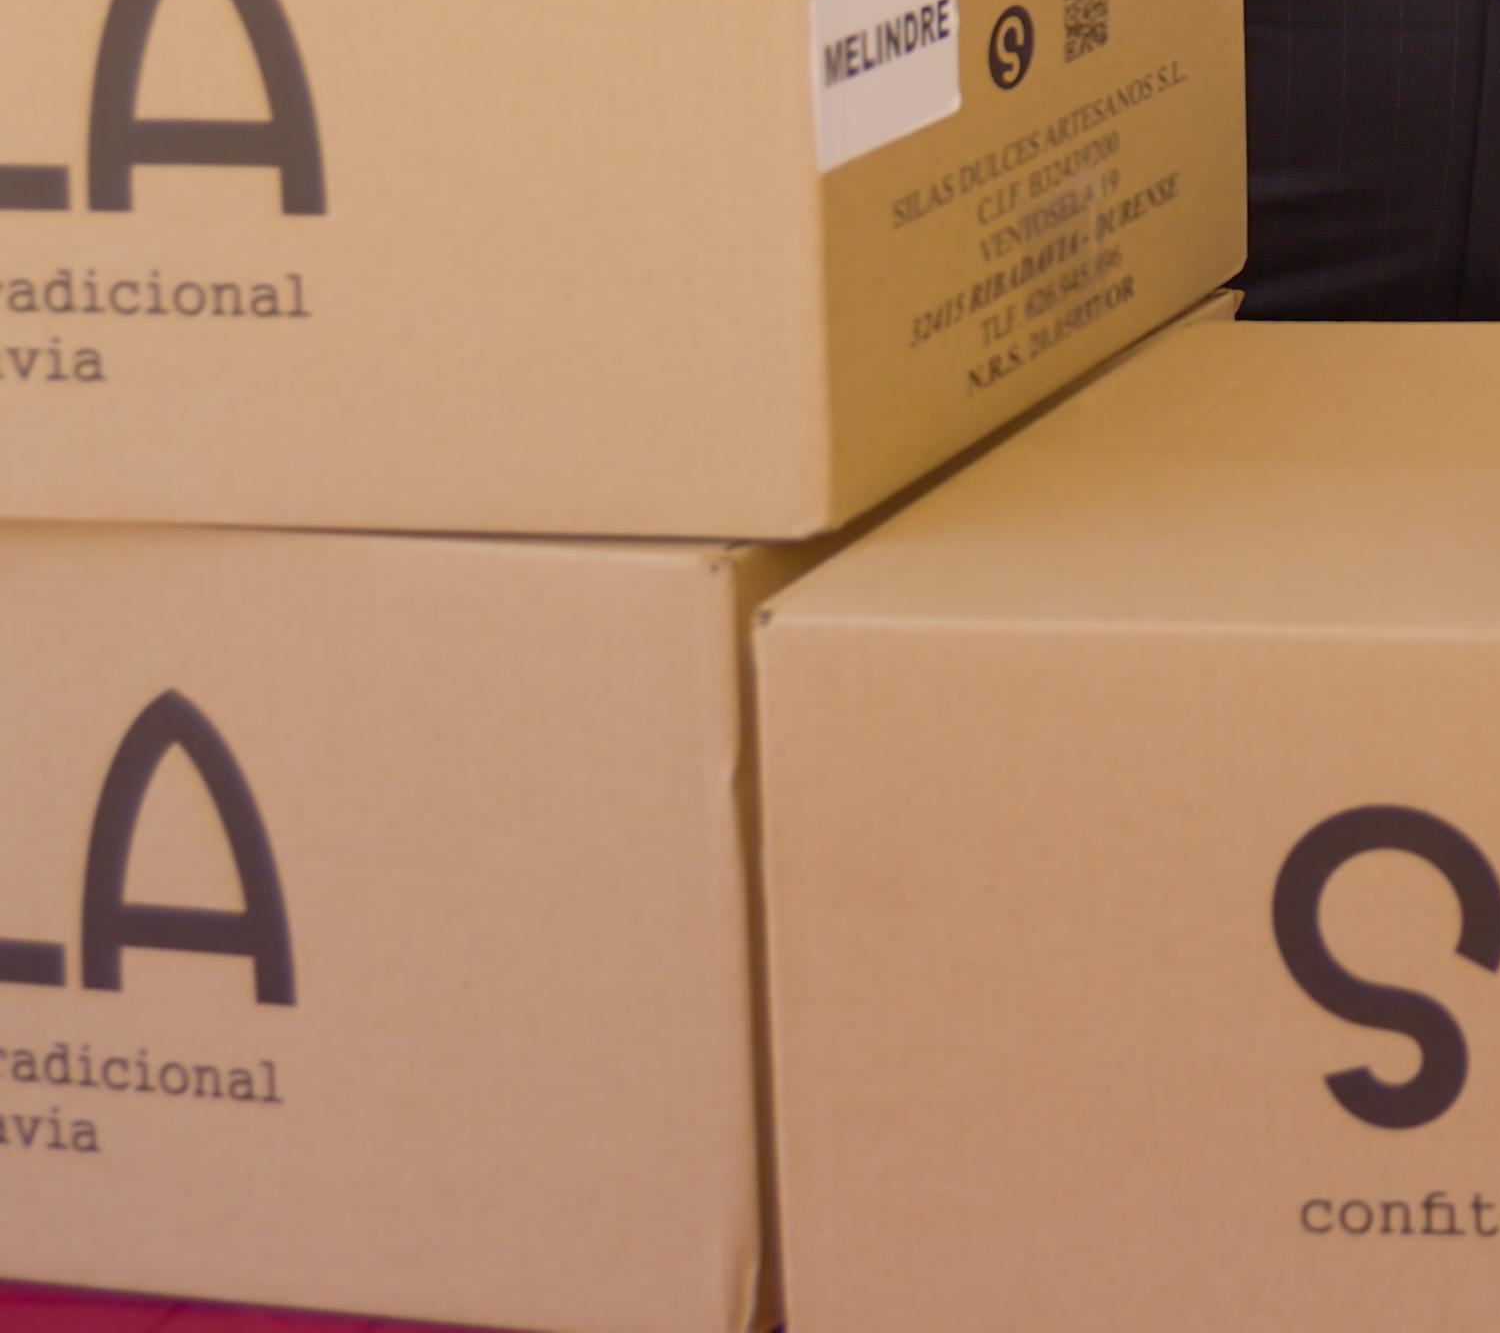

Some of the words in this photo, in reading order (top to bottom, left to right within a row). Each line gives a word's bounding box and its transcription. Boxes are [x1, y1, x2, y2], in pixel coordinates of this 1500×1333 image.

[892, 176, 956, 230] SILAS
[959, 131, 1041, 198] DULCES
[1044, 74, 1154, 150] ARTESANOS
